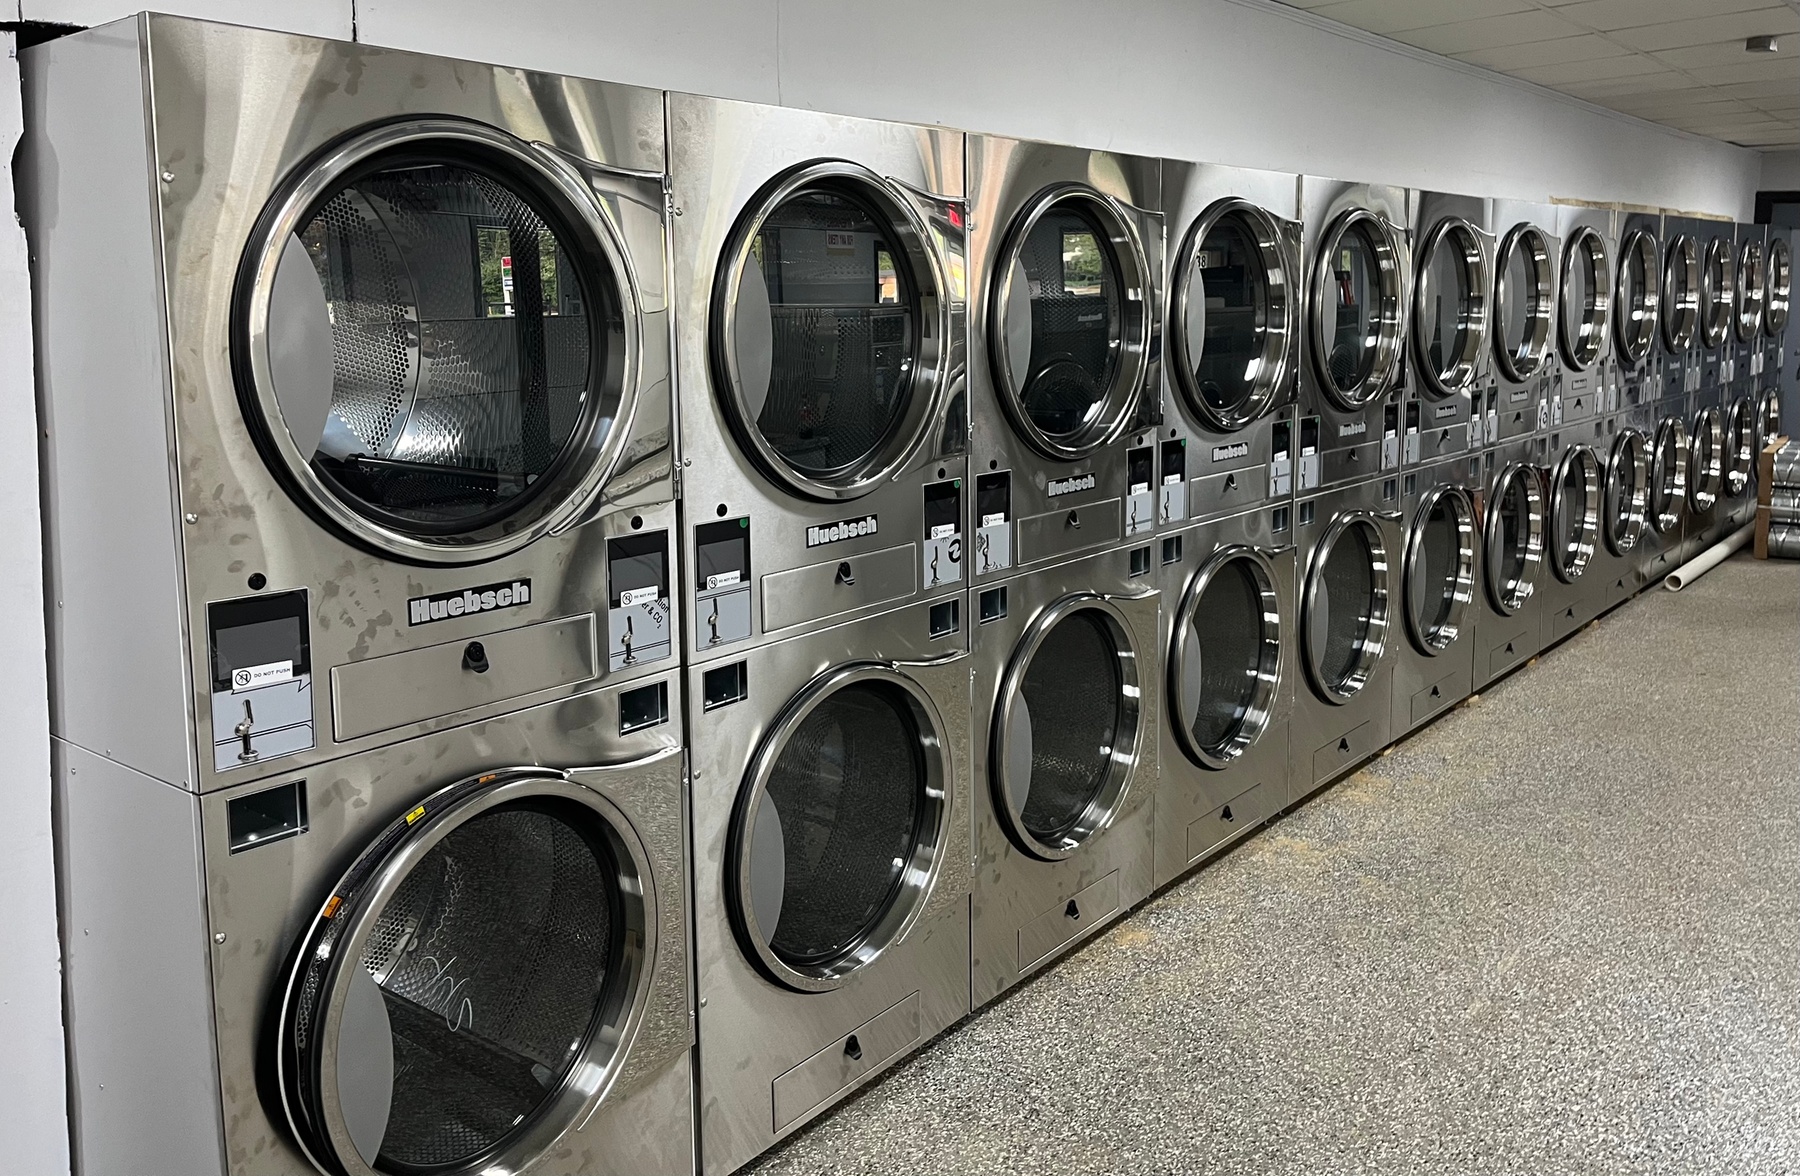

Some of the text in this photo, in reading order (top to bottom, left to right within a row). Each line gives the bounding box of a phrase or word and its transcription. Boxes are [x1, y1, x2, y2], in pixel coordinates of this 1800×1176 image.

[808, 516, 877, 547] Huebsch
[410, 582, 529, 624] Huebsch
[648, 606, 655, 616] &
